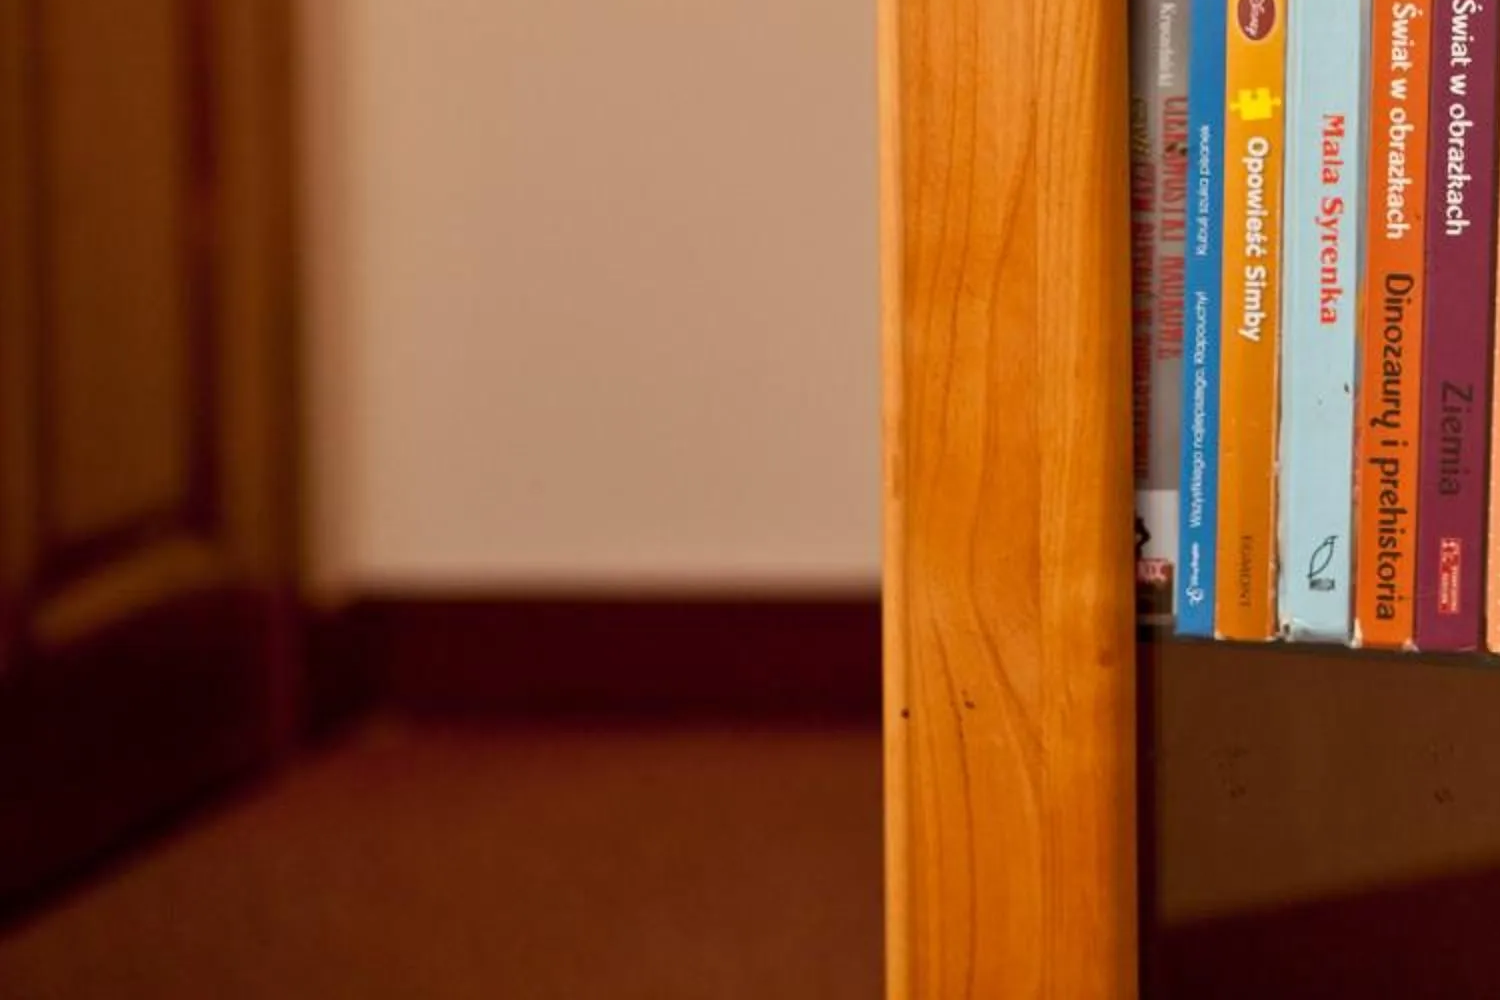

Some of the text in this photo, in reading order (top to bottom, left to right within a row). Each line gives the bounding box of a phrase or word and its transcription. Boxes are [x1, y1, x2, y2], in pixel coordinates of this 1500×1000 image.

[1386, 1, 1424, 240] Świat w obrazkach
[1448, 74, 1468, 96] w
[1239, 136, 1270, 341] Opowieść Simby
[1446, 103, 1474, 236] obrazkach
[1314, 196, 1345, 325] Syrenka
[1370, 273, 1416, 428] Dinozaury
[1439, 381, 1475, 496] Ziemia
[1369, 457, 1408, 621] prehistoria
